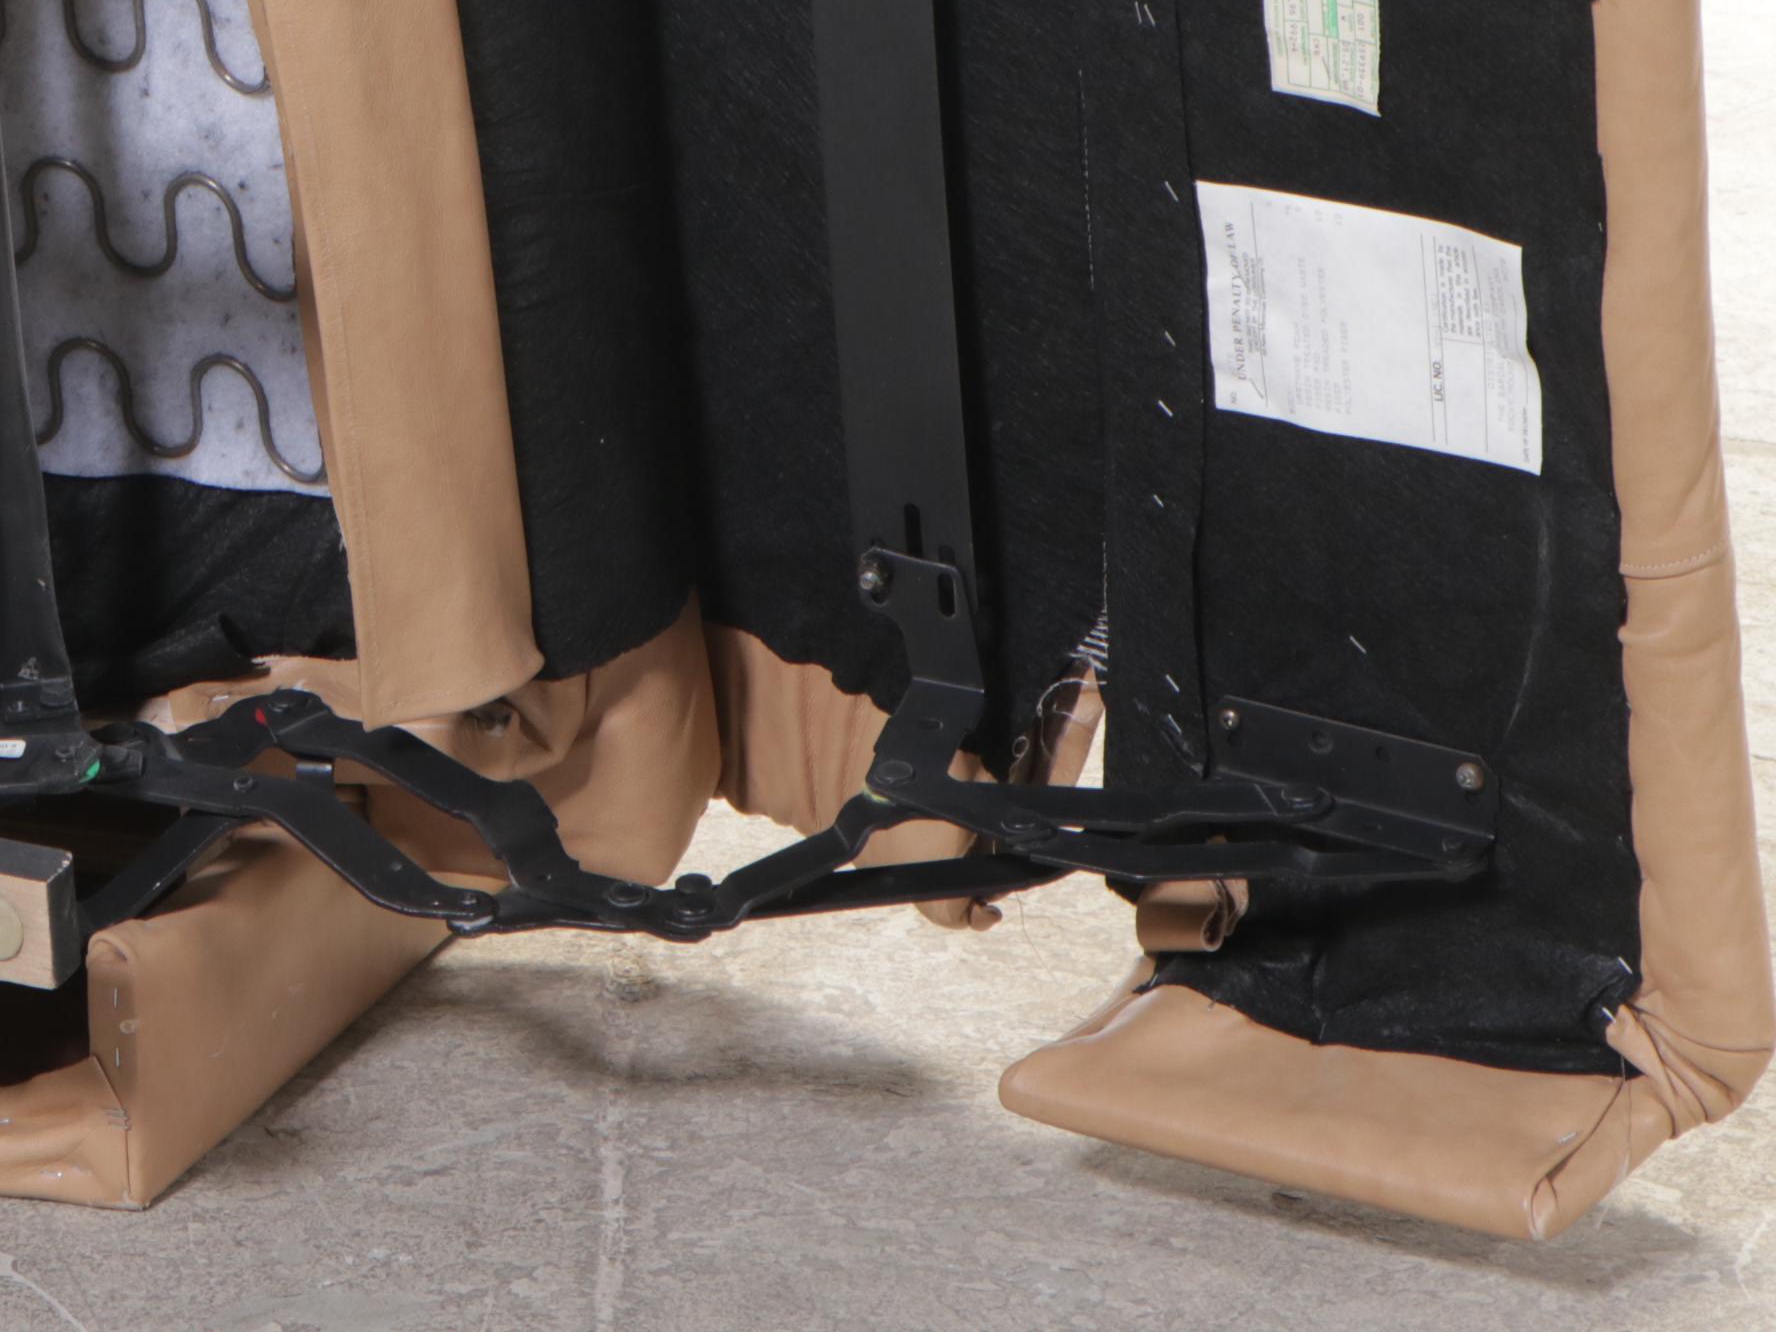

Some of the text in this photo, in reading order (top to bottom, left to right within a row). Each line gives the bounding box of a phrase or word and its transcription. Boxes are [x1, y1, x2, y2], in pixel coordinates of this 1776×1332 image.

[1223, 220, 1236, 250] LAW
[1230, 271, 1242, 334] PENALTY
[1232, 335, 1247, 382] UNDER
